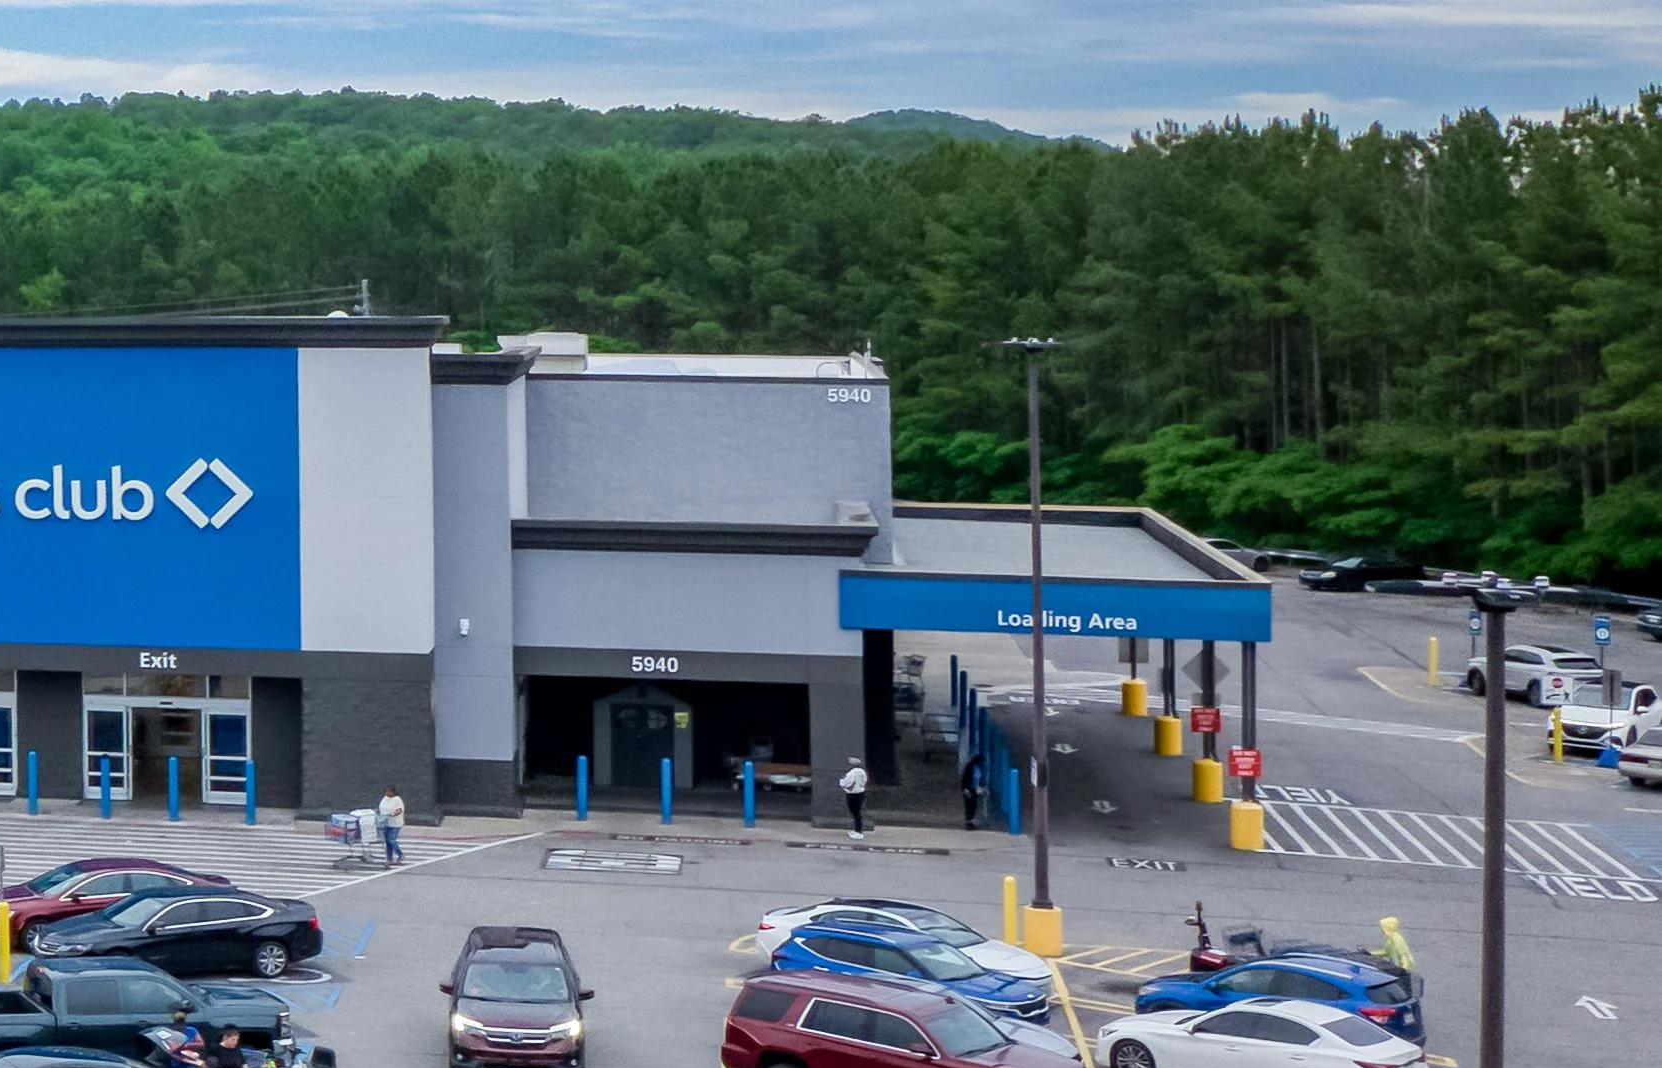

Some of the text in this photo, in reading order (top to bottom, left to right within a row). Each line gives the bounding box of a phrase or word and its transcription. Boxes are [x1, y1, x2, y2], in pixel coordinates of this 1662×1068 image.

[827, 388, 872, 403] 5940
[14, 463, 154, 521] club
[1088, 613, 1138, 630] Area
[139, 652, 178, 669] Exit
[631, 655, 679, 673] 5940
[1111, 858, 1177, 871] EXIT
[1522, 873, 1659, 902] YIELD
